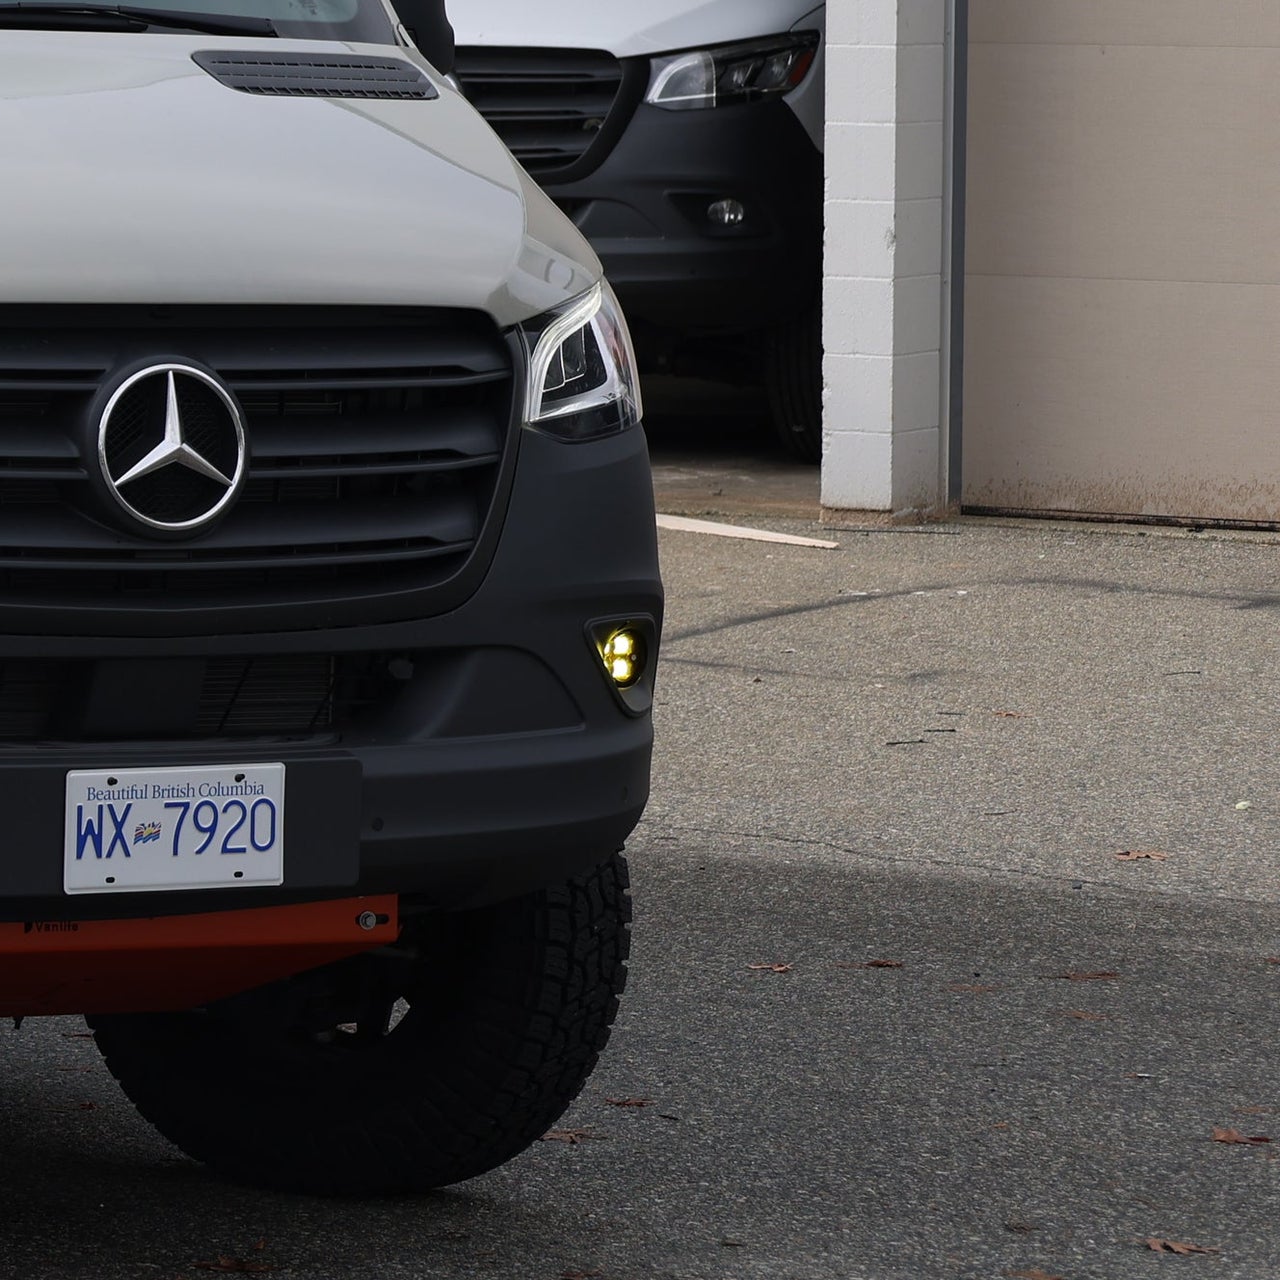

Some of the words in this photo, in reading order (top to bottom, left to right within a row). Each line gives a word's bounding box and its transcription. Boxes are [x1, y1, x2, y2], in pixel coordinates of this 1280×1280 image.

[86, 786, 148, 801] Beautiful
[152, 783, 195, 800] British
[198, 781, 264, 798] Columbia
[75, 802, 133, 860] WX
[163, 797, 277, 857] 7920
